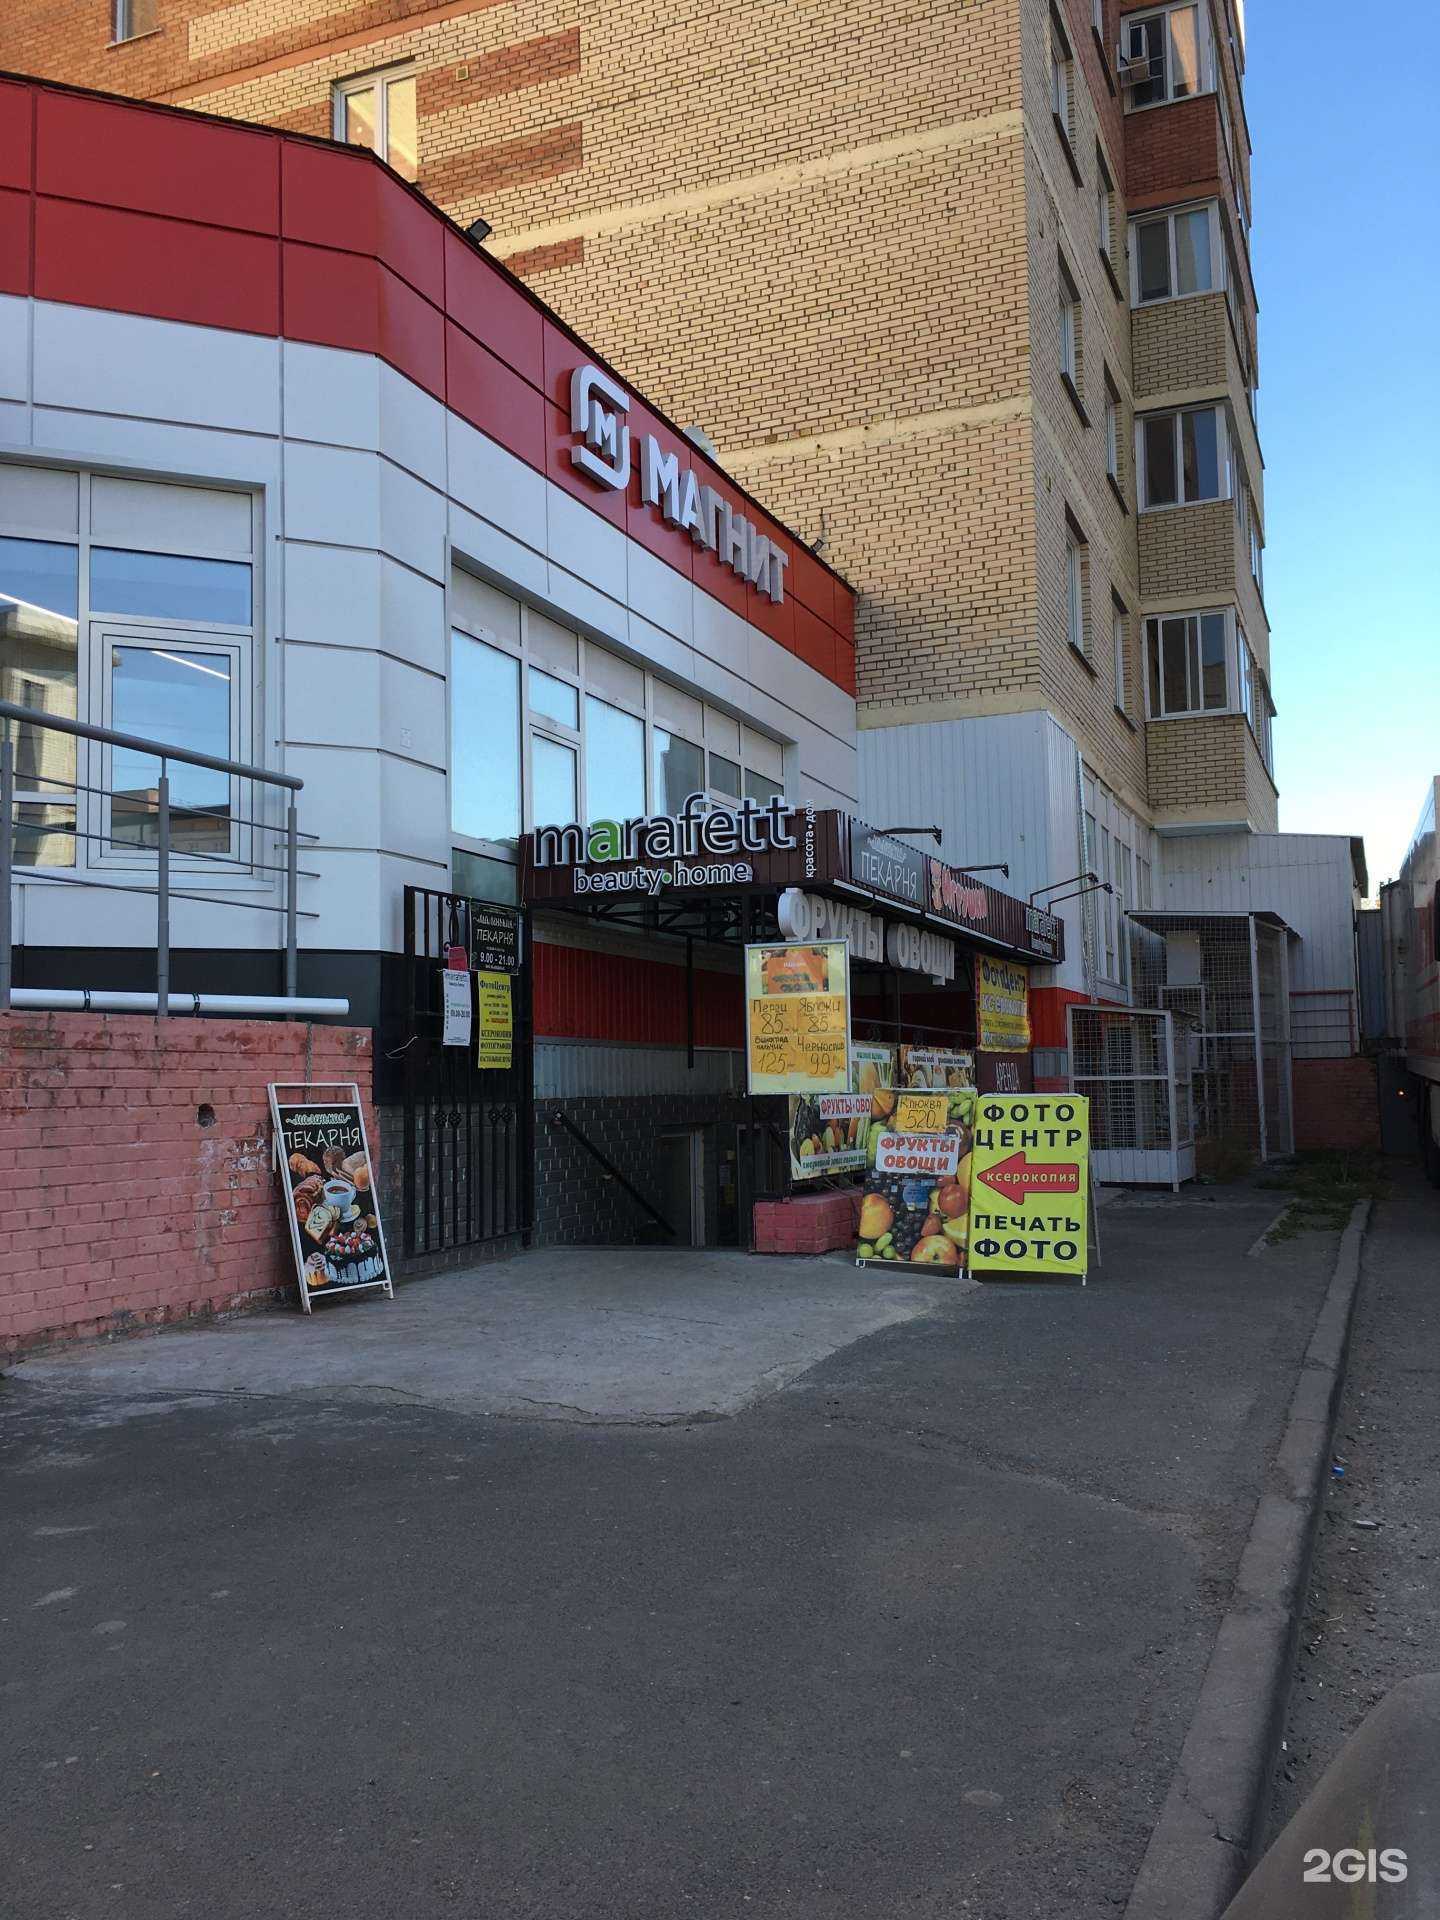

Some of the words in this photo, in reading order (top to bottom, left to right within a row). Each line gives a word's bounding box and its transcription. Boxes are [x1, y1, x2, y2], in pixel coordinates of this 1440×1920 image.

[641, 434, 789, 605] МАГНИТ
[534, 791, 797, 868] marafett
[806, 830, 816, 878] красота
[861, 851, 917, 900] ПЕКАРНЯ
[476, 929, 514, 945] ПЕКАРНЯ
[761, 1012, 784, 1035] 85
[758, 1052, 788, 1074] 125
[810, 1052, 831, 1075] 99
[904, 1109, 937, 1129] 520
[983, 1104, 1075, 1123] ФОТО
[880, 1136, 956, 1153] ФРУКТЫ
[975, 1129, 1082, 1150] ЦЕНТР
[883, 1154, 950, 1171] ОВОЩИ
[986, 1171, 1077, 1185] ксерокопия
[974, 1214, 1081, 1232] ПЕЧАТЬ
[973, 1238, 1078, 1261] ФОТО
